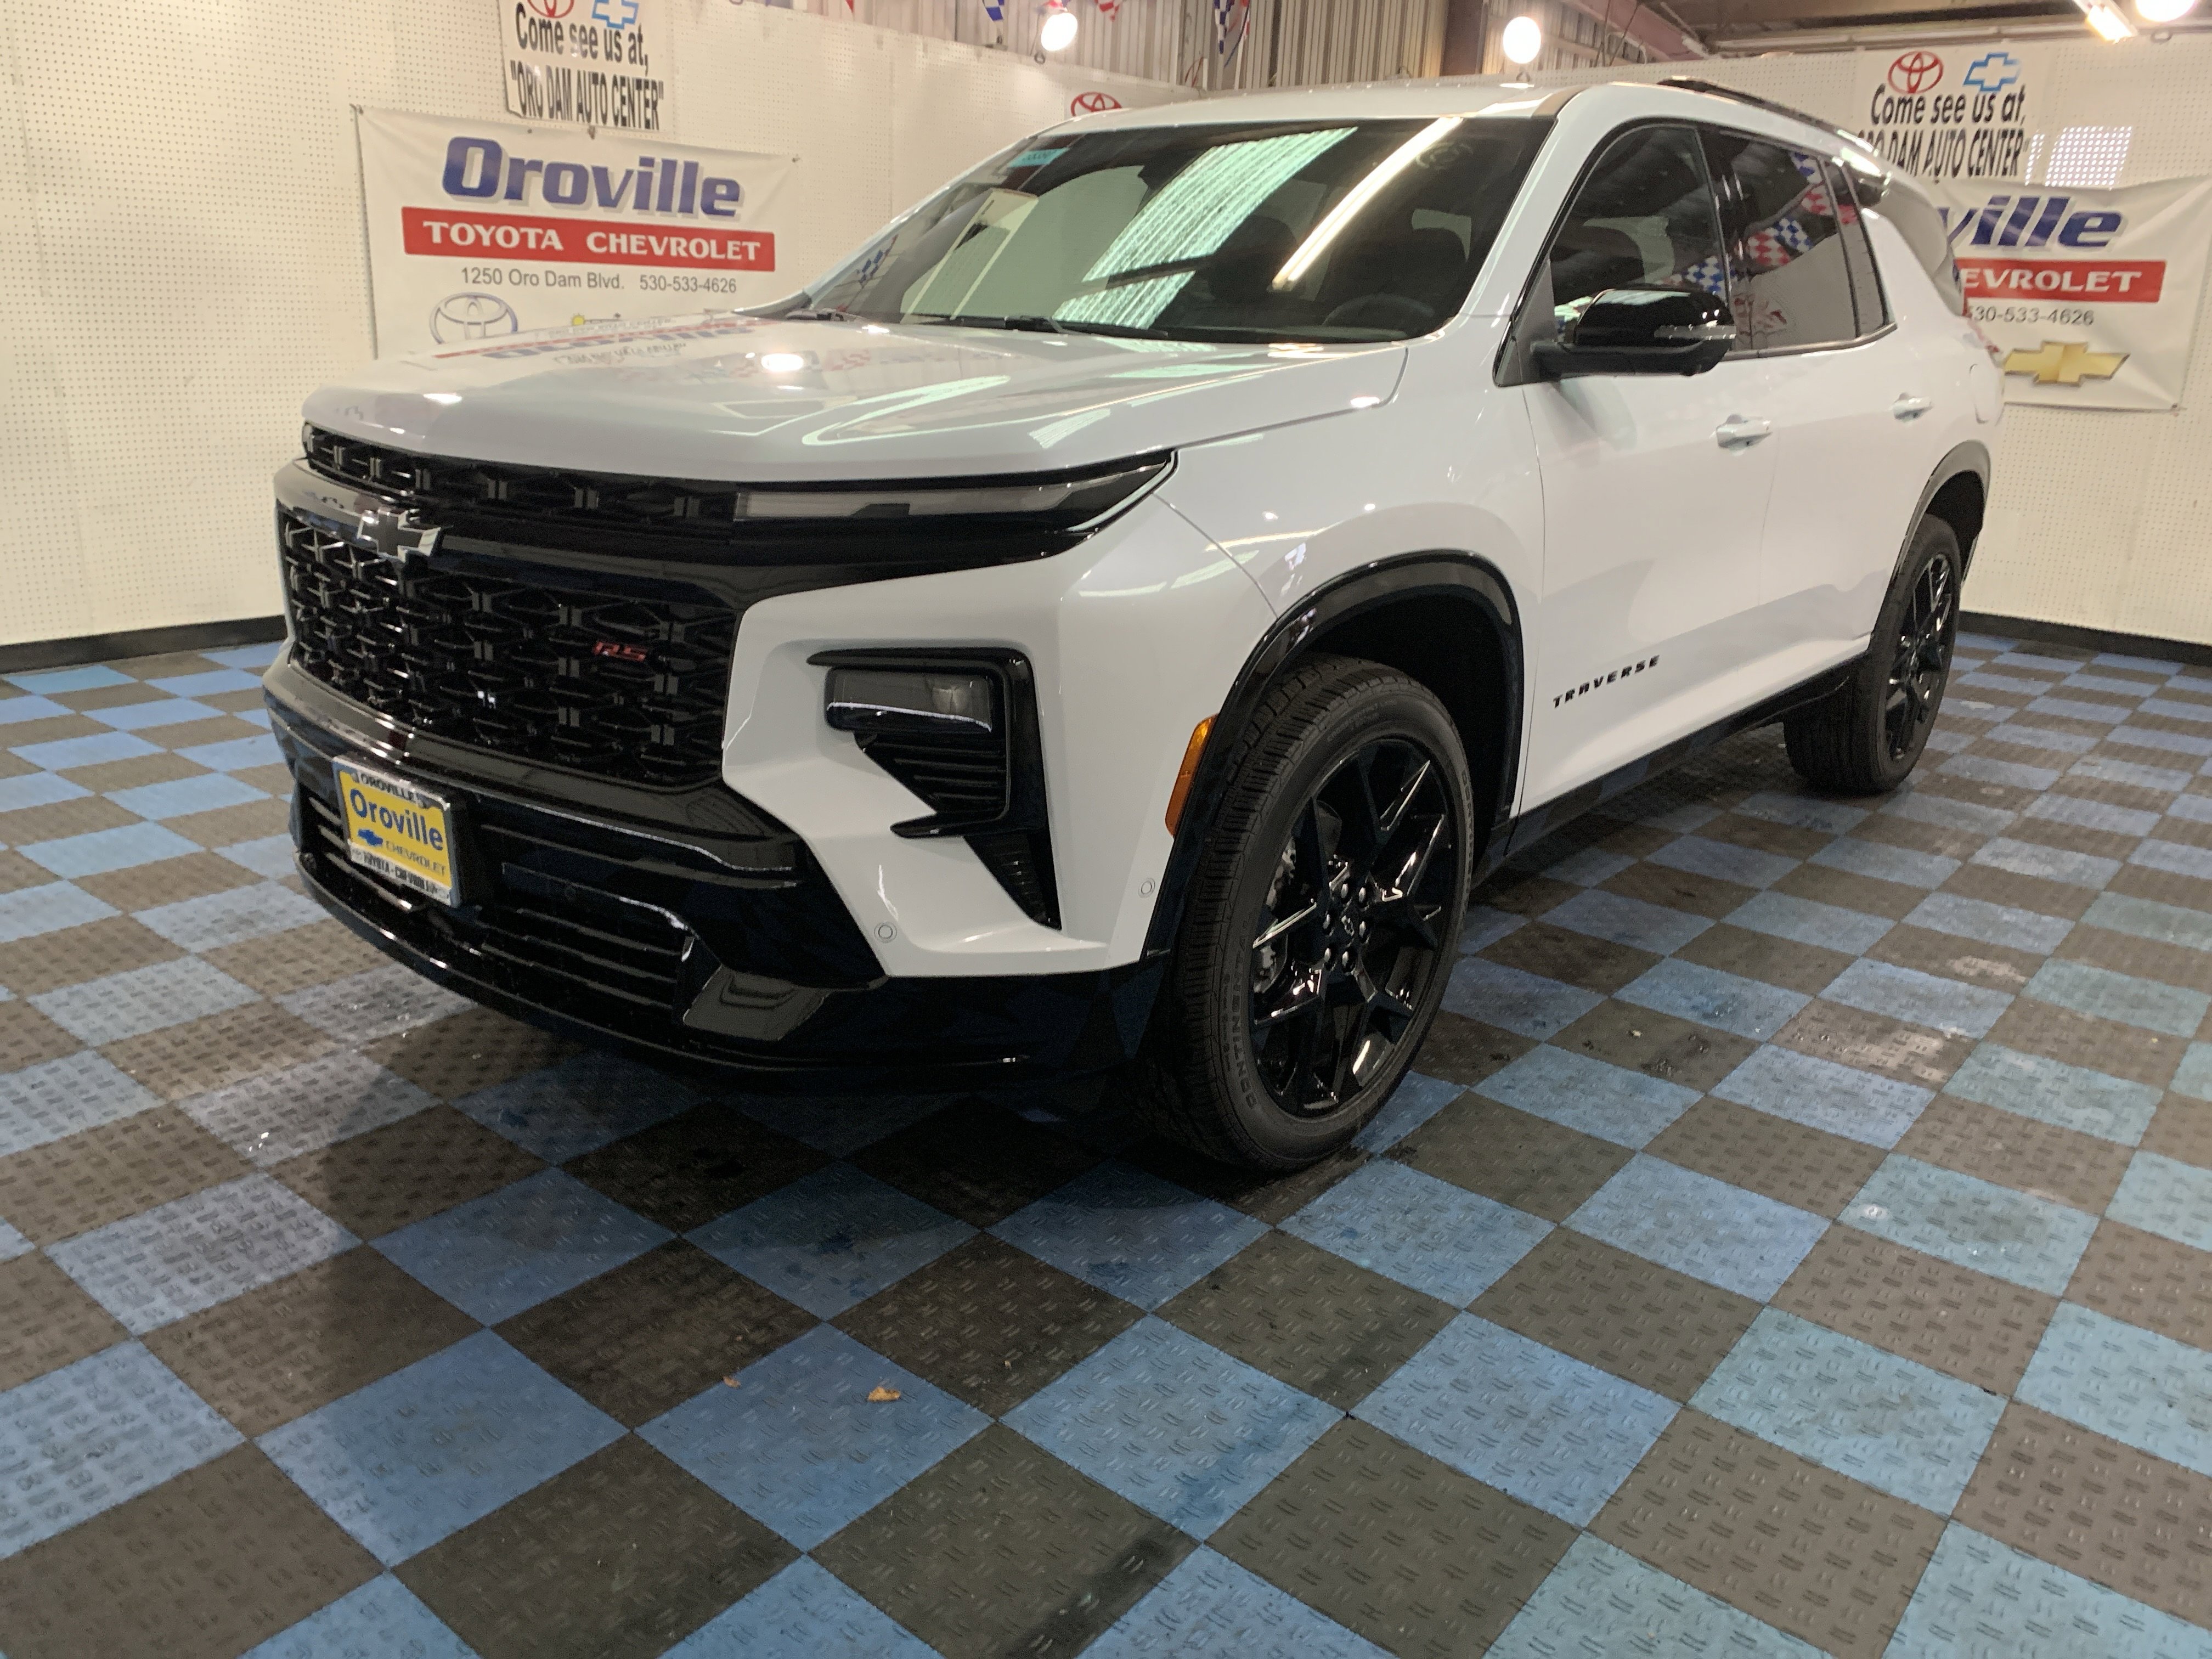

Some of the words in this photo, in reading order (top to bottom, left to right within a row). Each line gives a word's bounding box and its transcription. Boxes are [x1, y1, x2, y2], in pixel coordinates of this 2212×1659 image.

[516, 2, 563, 54] Come
[569, 23, 599, 59] see
[603, 29, 623, 63] us
[628, 23, 648, 76] at,
[510, 59, 543, 118] "ORO
[545, 65, 573, 121] DAM
[577, 70, 608, 125] AUTO
[611, 74, 664, 130] CENTER"
[1871, 83, 1926, 125] Come
[1931, 93, 1966, 124] see
[1972, 92, 1996, 123] us
[2001, 84, 2027, 126] at,
[442, 136, 742, 218] Oroville
[1887, 129, 1924, 177] DAM
[1922, 128, 1966, 178] AUTO
[1967, 127, 2029, 178] CENTER"
[423, 221, 564, 251] TOYOTA
[586, 231, 761, 261] CHEVROLET
[1937, 194, 2123, 248] ville
[461, 267, 503, 285] 1250
[509, 268, 539, 286] Oro
[545, 270, 581, 287] Dam
[587, 272, 624, 289] Blvd.
[640, 274, 736, 293] 530-533-4626
[1961, 268, 2142, 292] EVROLET
[1553, 654, 1660, 709] TRAVERSE
[349, 787, 443, 851] Oroville
[386, 840, 446, 876] CHEVROLET
